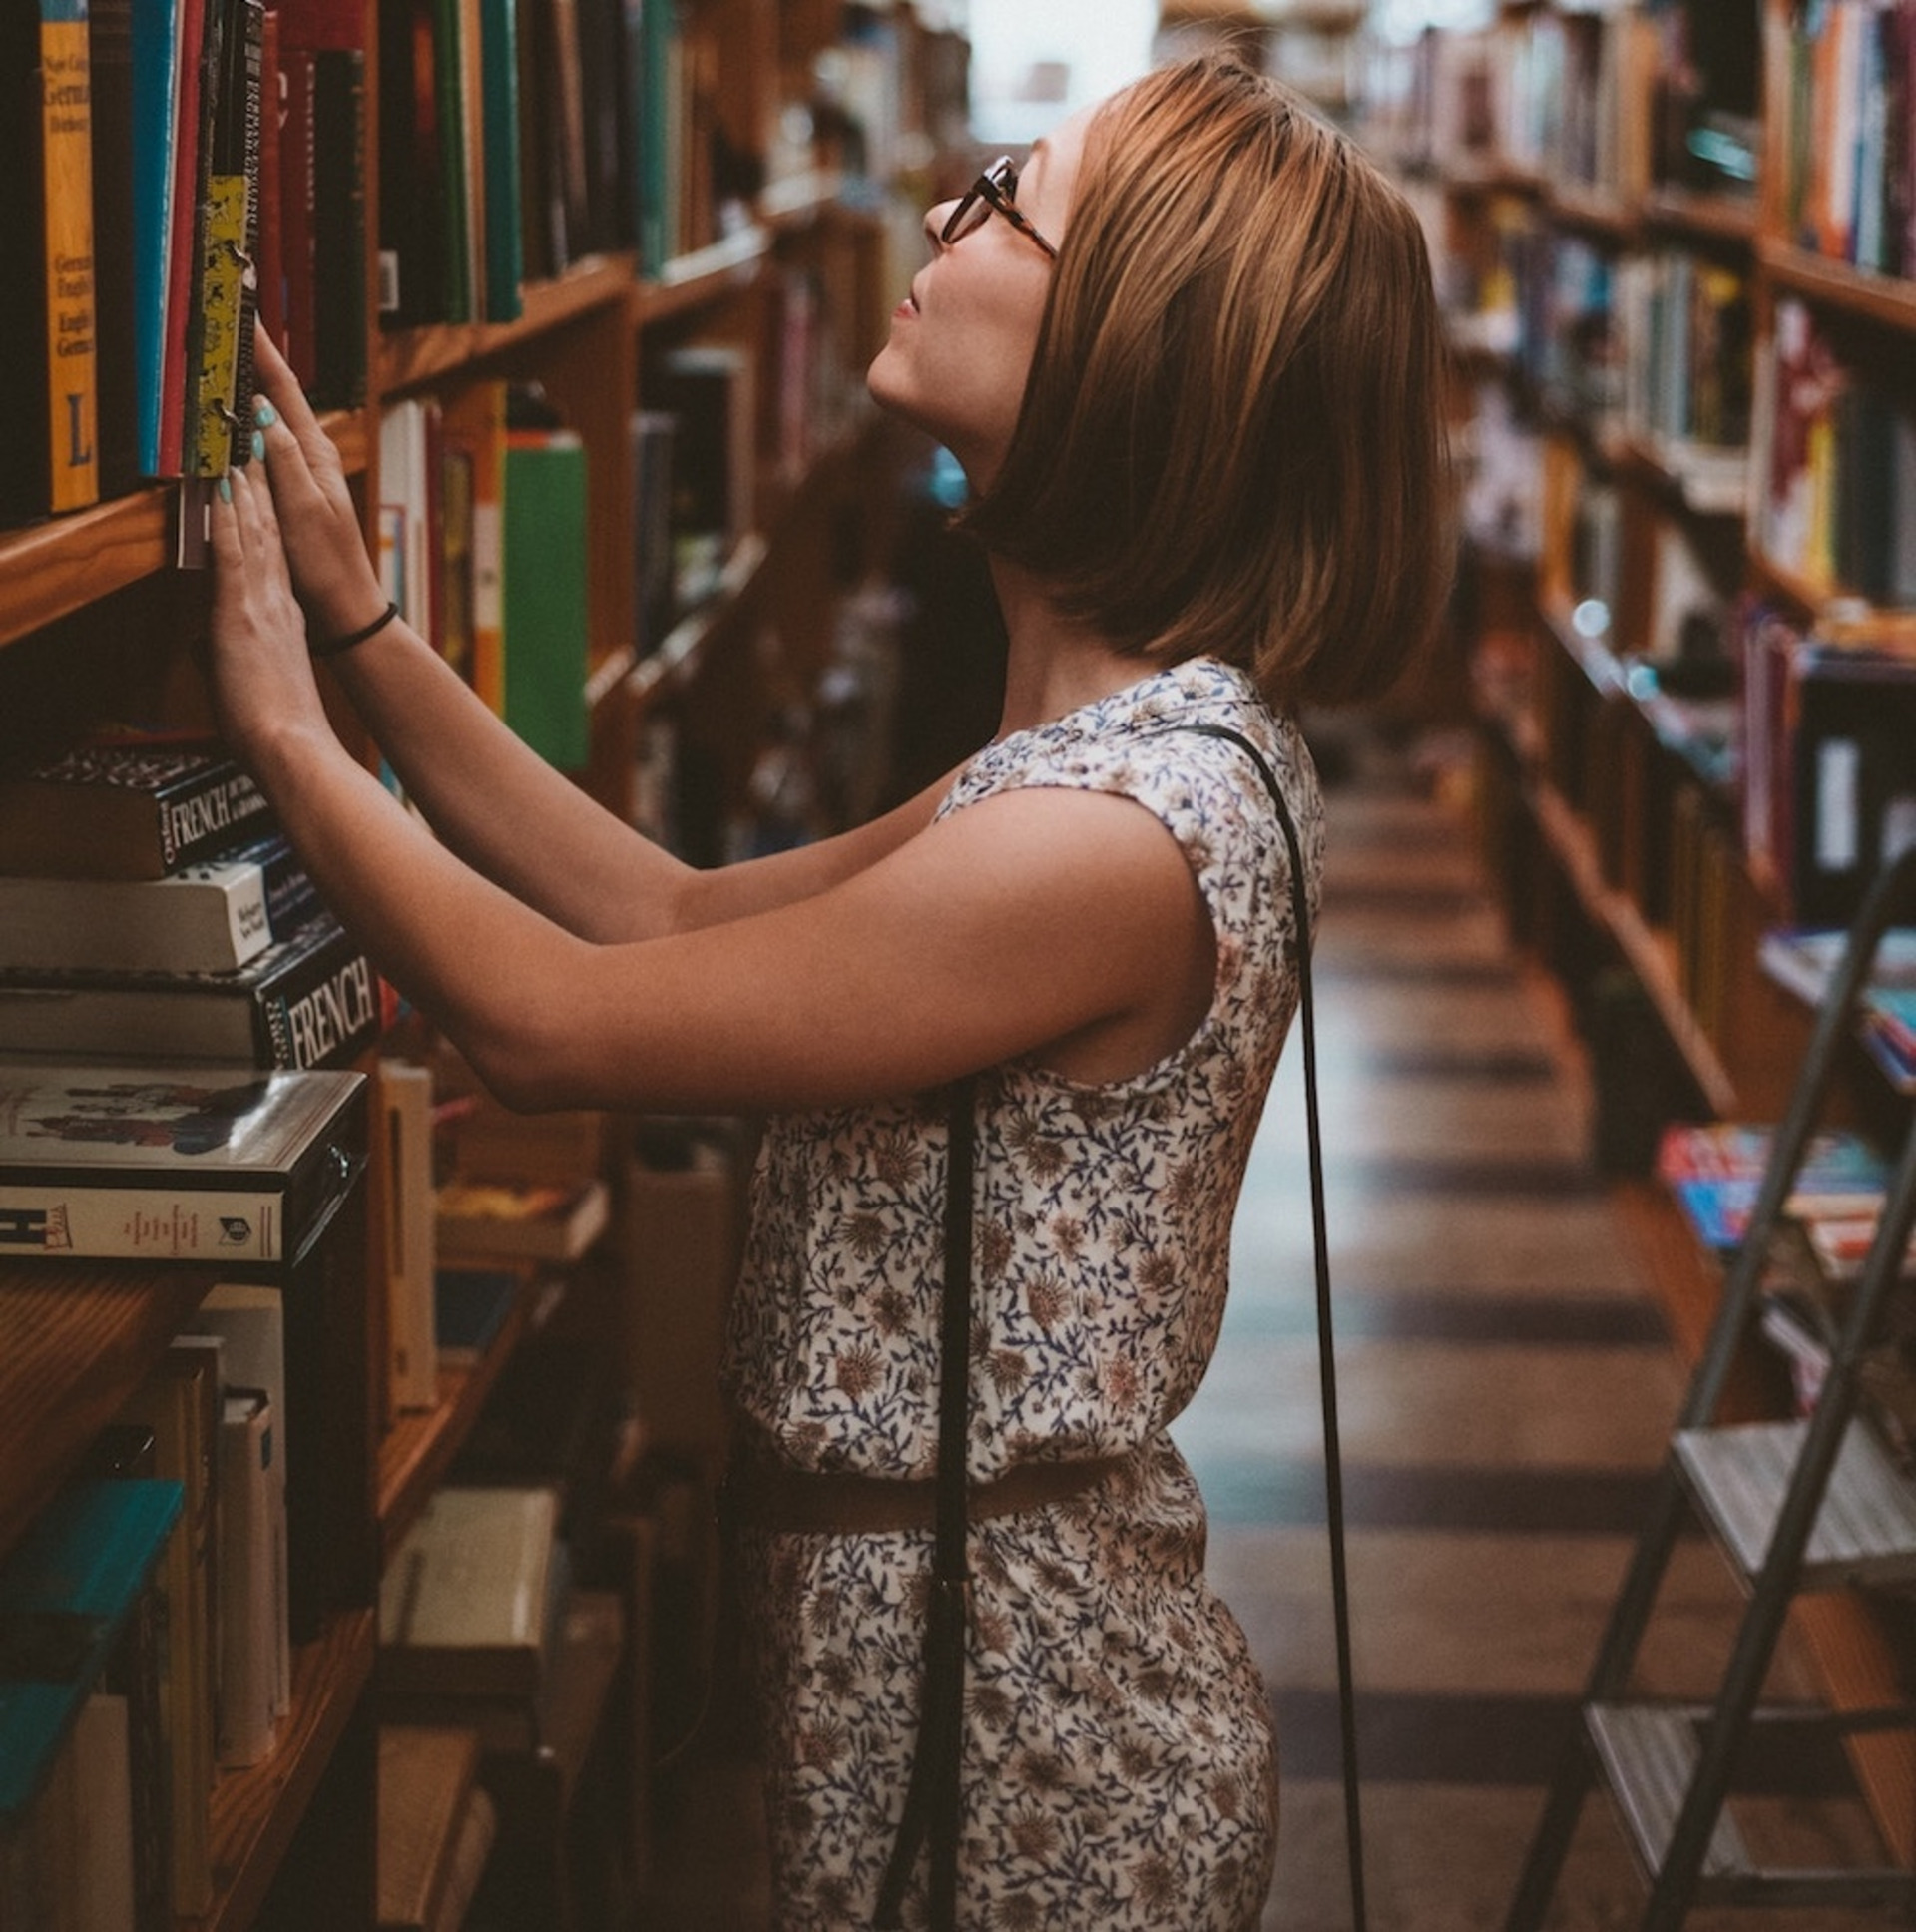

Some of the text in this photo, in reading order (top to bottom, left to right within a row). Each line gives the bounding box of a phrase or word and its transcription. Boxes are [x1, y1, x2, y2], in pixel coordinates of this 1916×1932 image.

[67, 393, 91, 467] L
[171, 784, 231, 848] FRENCH
[288, 955, 374, 1071] FRENCH
